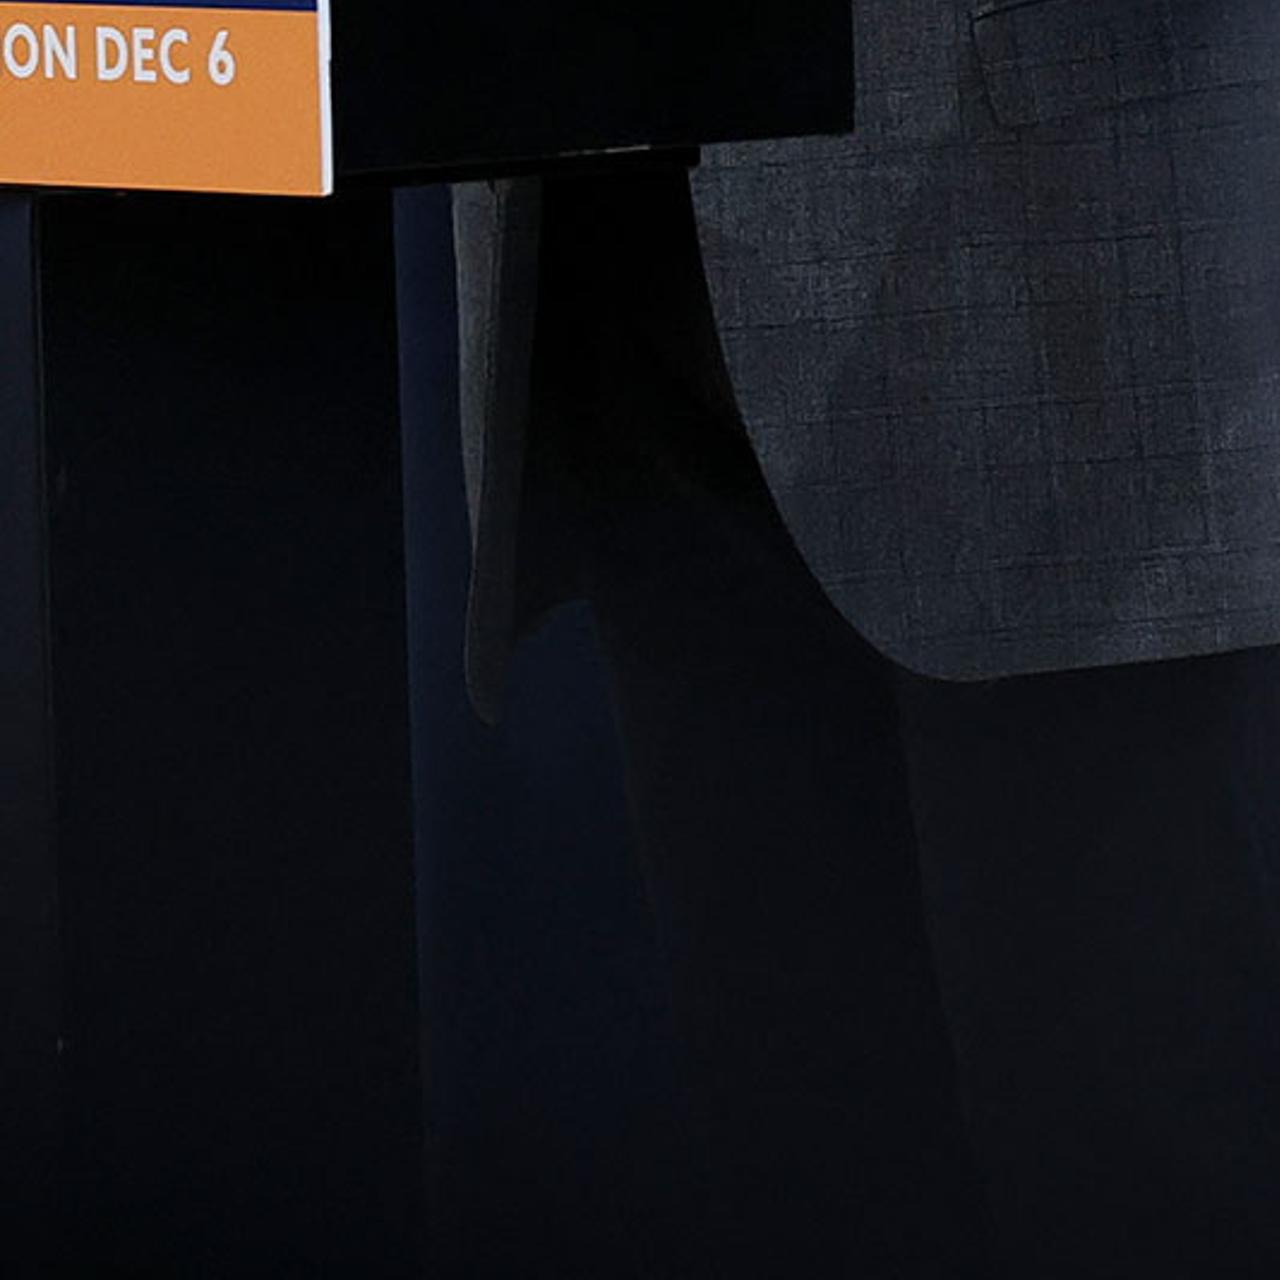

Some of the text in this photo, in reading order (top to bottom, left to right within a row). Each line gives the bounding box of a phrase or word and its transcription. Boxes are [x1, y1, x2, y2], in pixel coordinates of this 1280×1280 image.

[2, 22, 235, 86] ON DEC 6
